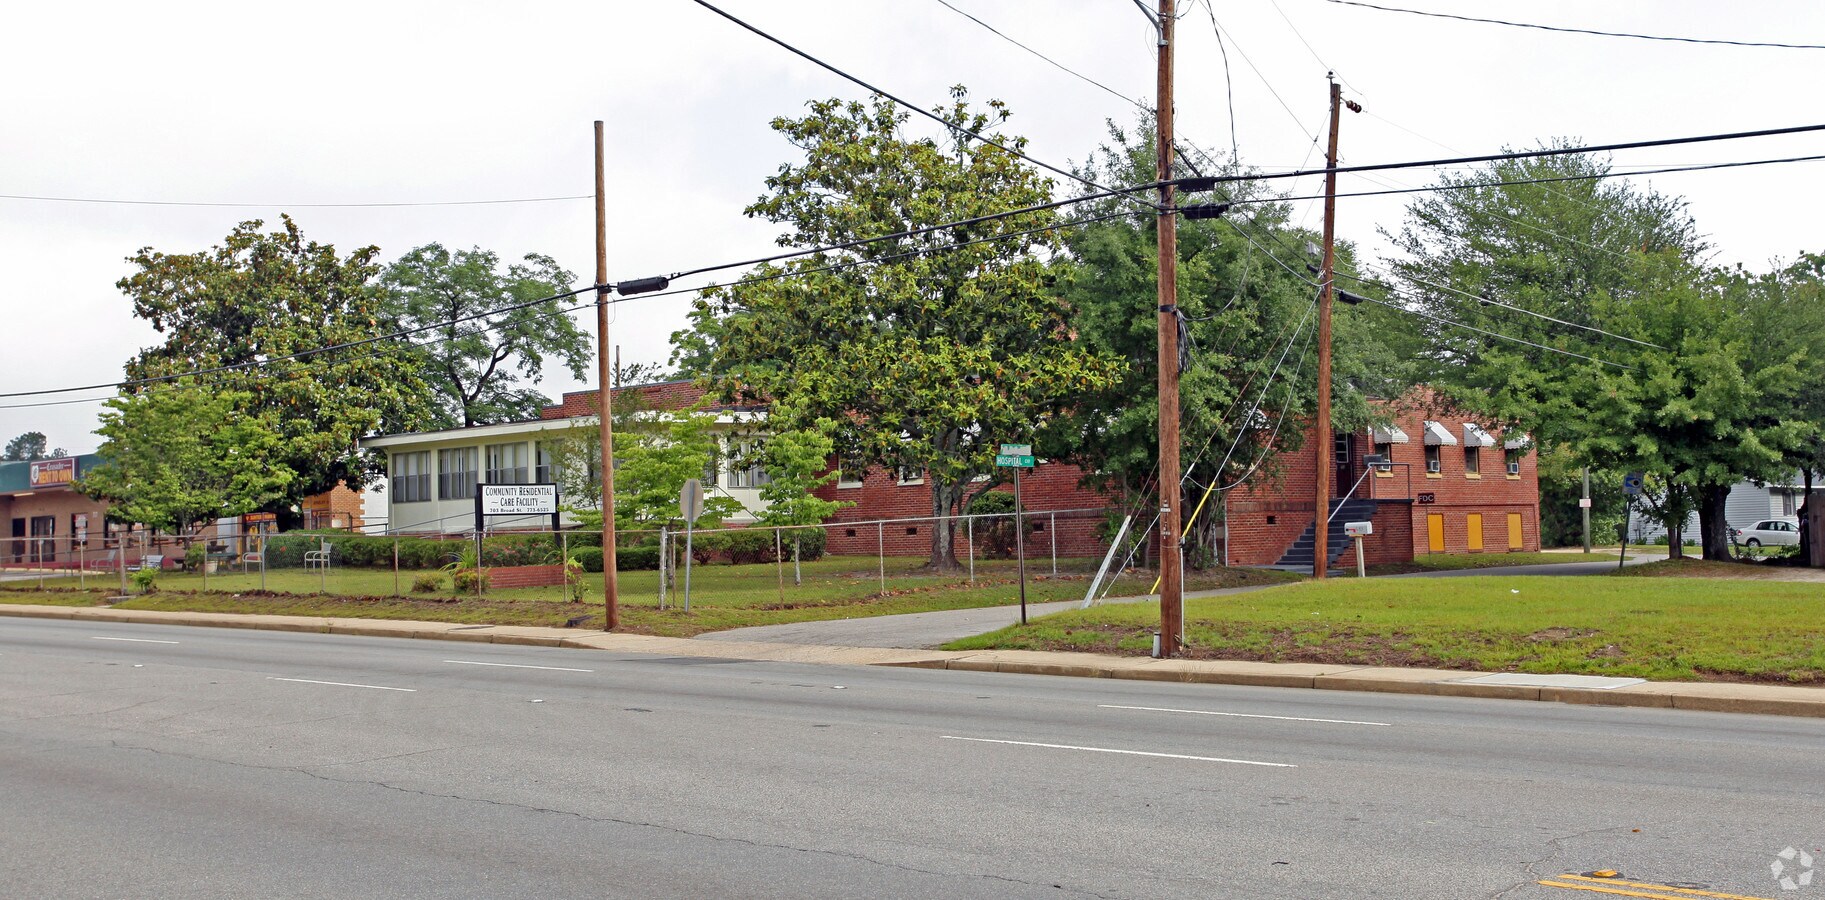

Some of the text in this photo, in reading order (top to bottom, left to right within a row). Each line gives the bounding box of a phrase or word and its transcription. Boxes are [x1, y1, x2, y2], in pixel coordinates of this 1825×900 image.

[997, 457, 1022, 465] HOSPITAL
[485, 486, 553, 496] COMMUNITY RESIDENTIAL
[500, 497, 538, 506] CARE FACILITY
